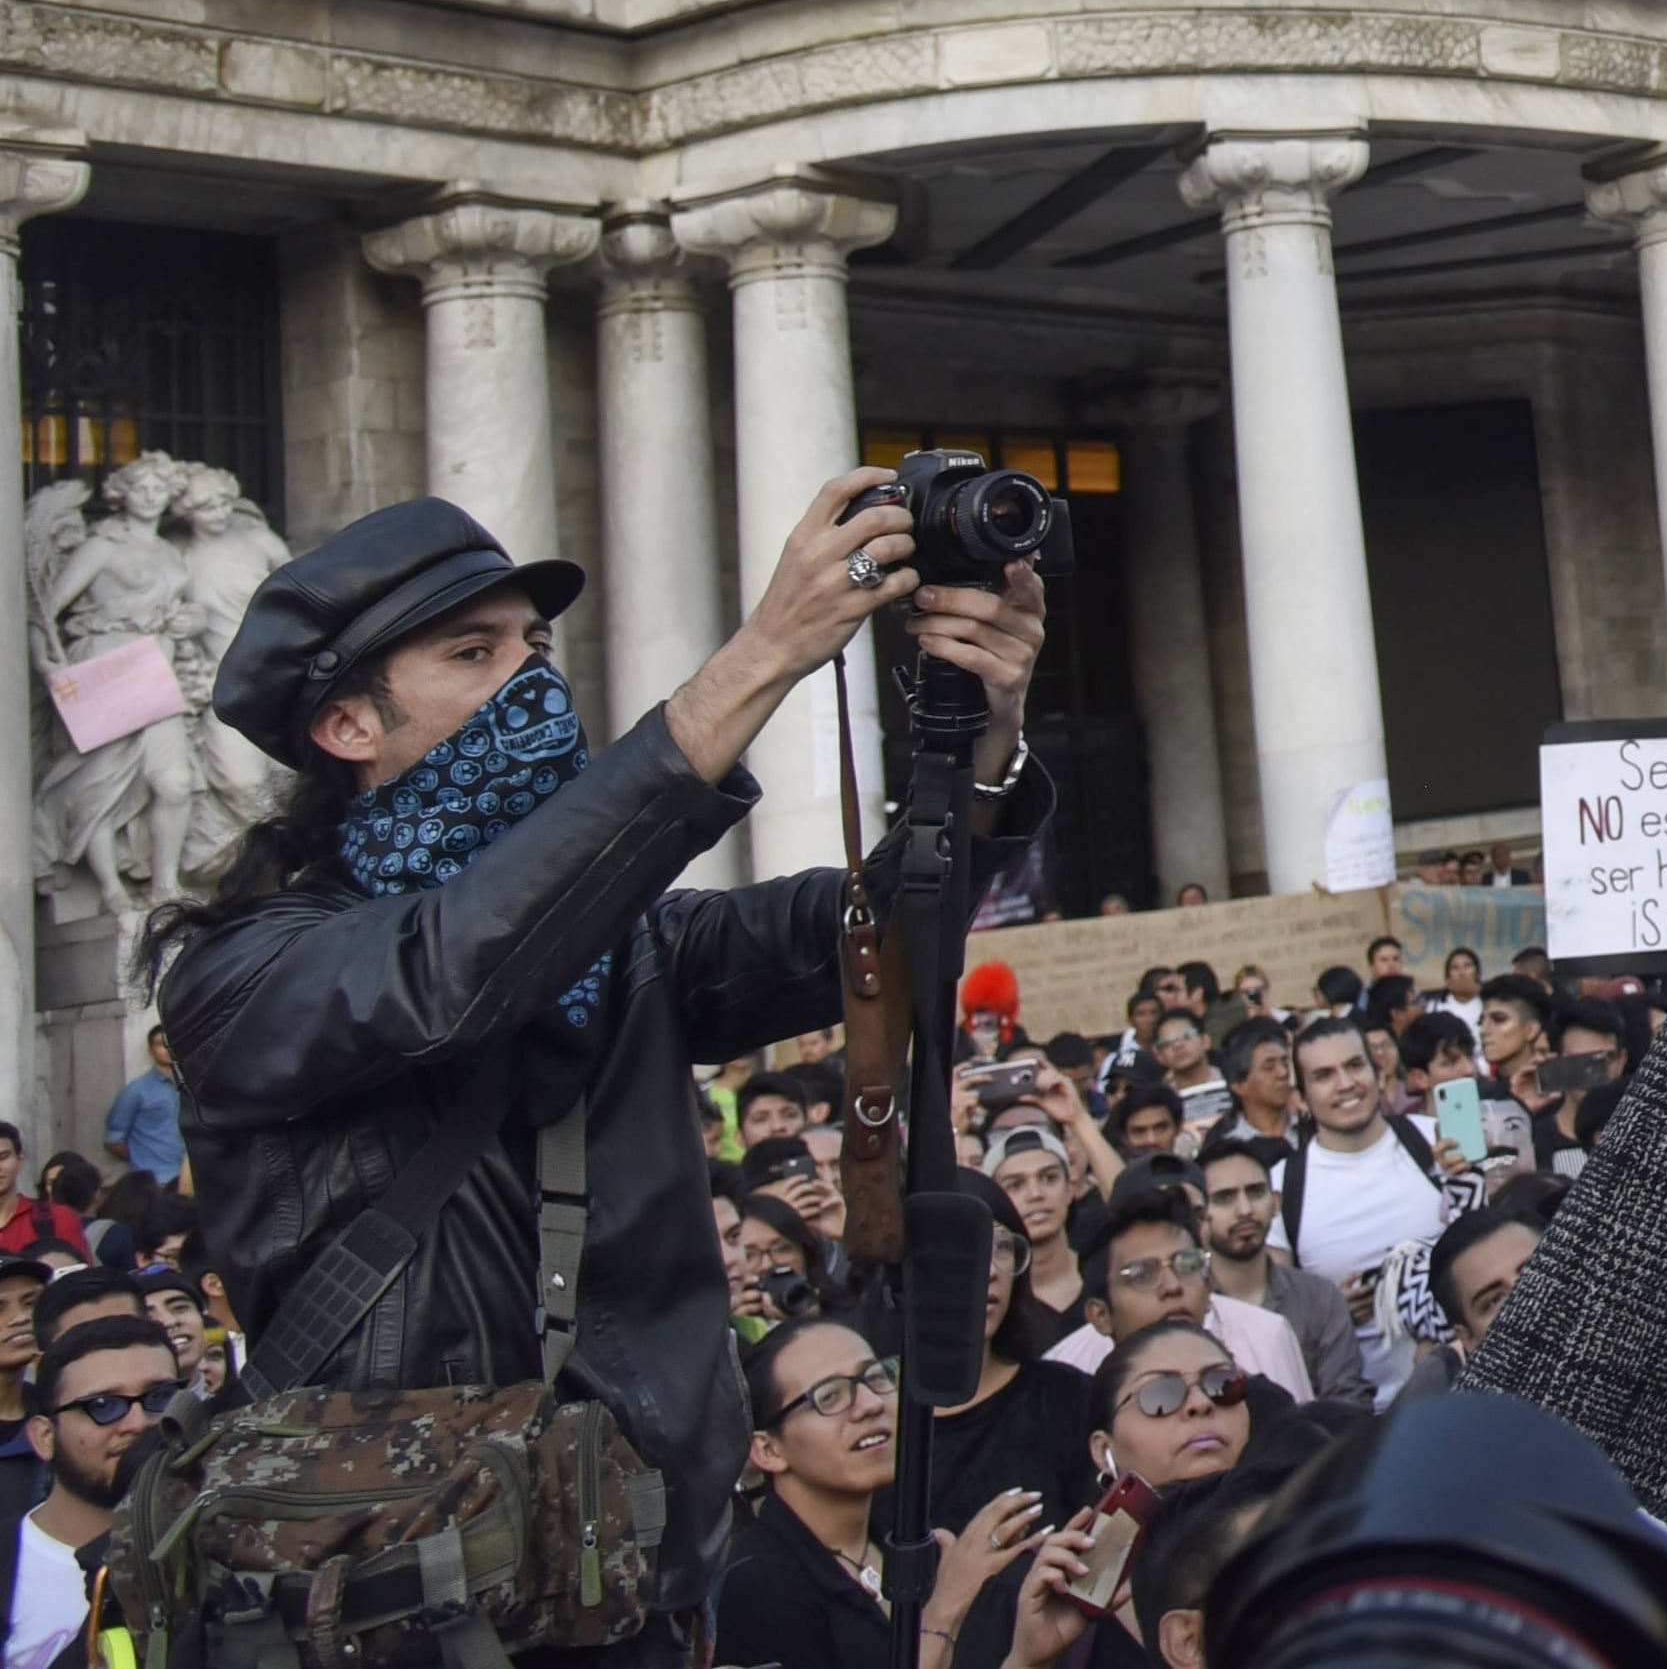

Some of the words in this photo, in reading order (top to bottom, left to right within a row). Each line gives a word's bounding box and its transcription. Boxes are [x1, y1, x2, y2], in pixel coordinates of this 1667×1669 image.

[948, 457, 980, 467] Nikon
[1578, 795, 1624, 845] NO
[1590, 866, 1644, 895] ser
